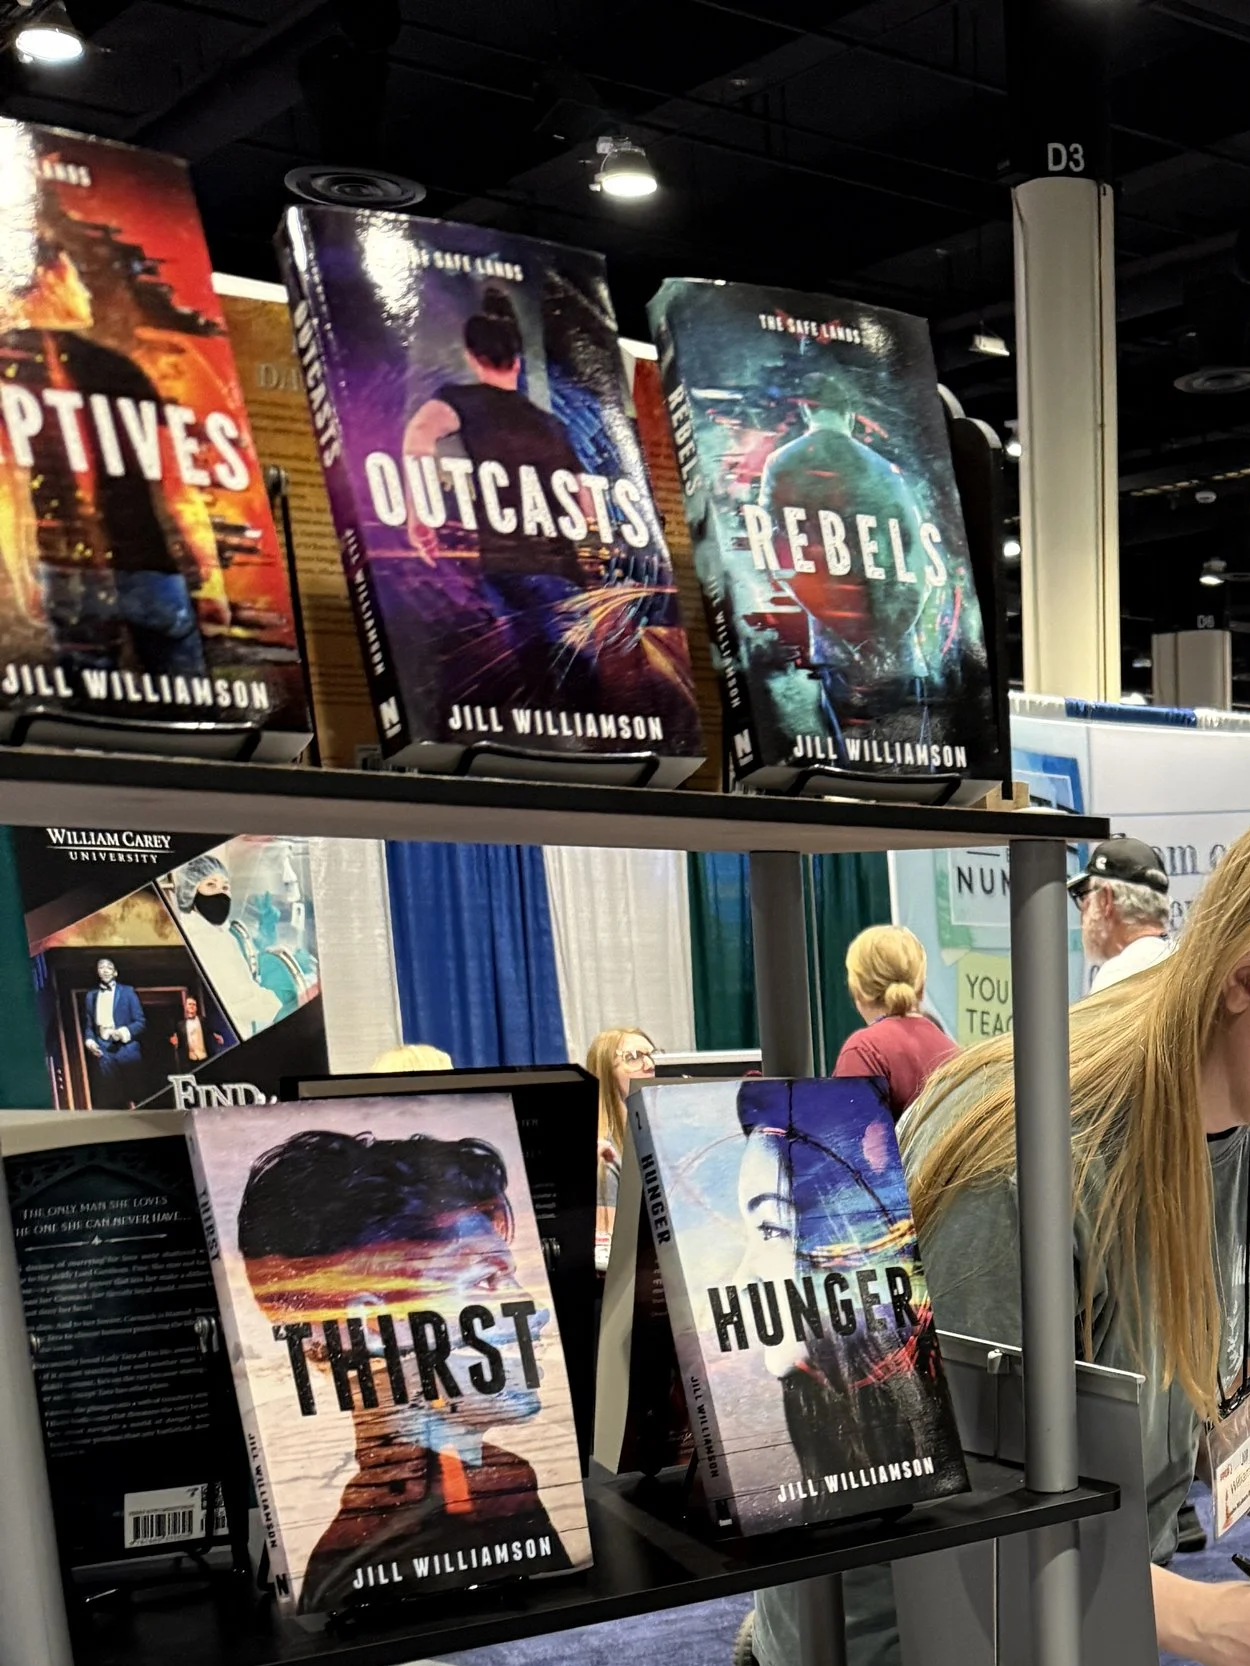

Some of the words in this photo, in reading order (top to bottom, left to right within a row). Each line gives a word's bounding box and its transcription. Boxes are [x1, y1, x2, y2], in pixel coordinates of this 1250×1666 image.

[1046, 142, 1085, 172] D3
[475, 257, 524, 282] LANDS
[758, 313, 785, 333] THE
[787, 317, 819, 338] SAFE
[821, 322, 862, 345] LANDS
[293, 300, 341, 468] OUTCASTS
[0, 388, 249, 492] PTIVES
[667, 384, 704, 498] REBELS
[364, 452, 650, 549] OUTCASTS
[743, 503, 948, 588] REBELS
[2, 663, 73, 699] JILL
[84, 665, 270, 711] WILLIAMSON
[449, 703, 503, 734] JILL
[512, 707, 664, 743] WILLIAMSON
[793, 734, 838, 761] JILL
[845, 737, 968, 769] WILLIAMSON
[46, 828, 121, 849] WILLIAM
[123, 830, 172, 850] CAREY
[69, 850, 160, 864] UNIVERSITY
[966, 1008, 1013, 1037] TEAC
[47, 1203, 77, 1218] ONLY
[80, 1200, 107, 1213] MAN
[109, 1198, 130, 1211] SHE
[133, 1195, 168, 1208] LOVES
[640, 1153, 672, 1246] HUNGER
[33, 1222, 57, 1236] ONE
[61, 1220, 81, 1234] SHE
[85, 1217, 111, 1230] CAN
[112, 1213, 150, 1229] NEVER
[708, 1266, 922, 1354] HUNGER
[272, 1300, 543, 1418] THIRST
[690, 1375, 703, 1404] JILL
[696, 1404, 720, 1479] WILLIAMSON
[246, 1432, 260, 1462] JILL
[254, 1464, 279, 1549] WILLIAMSON
[777, 1476, 818, 1504] JILL
[824, 1456, 936, 1492] WILLIAMSON
[352, 1560, 404, 1590] JILL
[414, 1535, 553, 1577] WILLIAMSON
